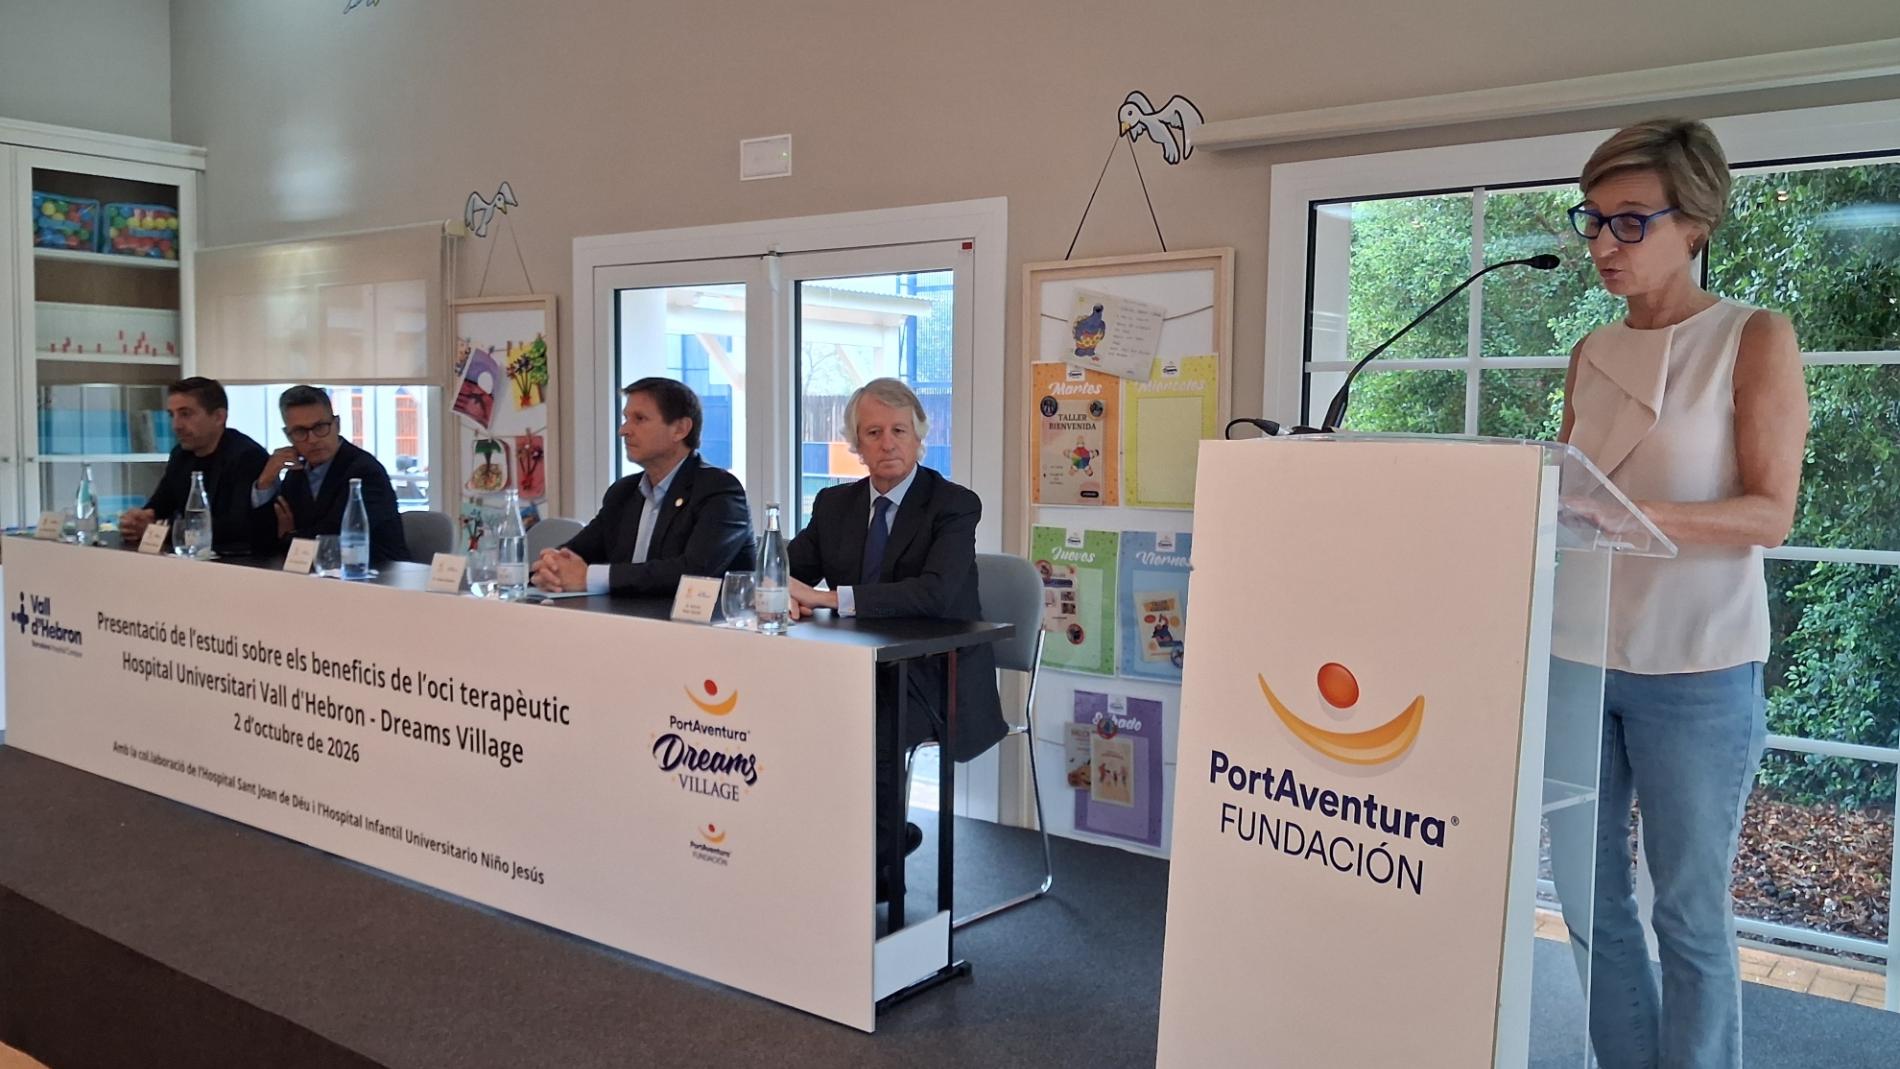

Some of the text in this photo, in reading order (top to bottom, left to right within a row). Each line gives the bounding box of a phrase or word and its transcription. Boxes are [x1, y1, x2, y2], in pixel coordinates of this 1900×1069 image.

[1048, 382, 1103, 395] Martes
[1048, 422, 1097, 431] BIENVENIDA
[1058, 413, 1087, 422] TALLER
[1051, 546, 1096, 563] Jueves
[30, 594, 50, 616] Vall
[32, 617, 83, 645] d'Hebron
[97, 611, 570, 725] Presentació de l'estudi sobre els beneficis de l'oci terapèutic
[122, 651, 173, 681] Hospital
[176, 662, 256, 700] Universitari
[259, 680, 287, 708] Vall
[291, 687, 365, 726] d'Hebron
[381, 709, 451, 747] Dreams
[456, 725, 523, 768] Village
[1092, 712, 1142, 731] Sbado
[233, 712, 360, 763] 2 d'octubre de 2026
[652, 733, 758, 786] Dreams
[678, 773, 740, 802] VILLAGE
[113, 741, 129, 756] Amb
[130, 745, 137, 758] la
[187, 762, 196, 777] de
[198, 765, 235, 787] l'Hospital
[237, 777, 256, 795] Sant
[257, 783, 278, 801] Joan
[279, 789, 290, 806] de
[292, 794, 310, 812] Déu
[317, 801, 362, 827] l'Hospital
[365, 817, 403, 841] Infantil
[405, 829, 478, 864] Universitario
[481, 851, 509, 875] Niño
[511, 860, 545, 885] Jesús
[1220, 802, 1424, 895] FUNDACIÓN
